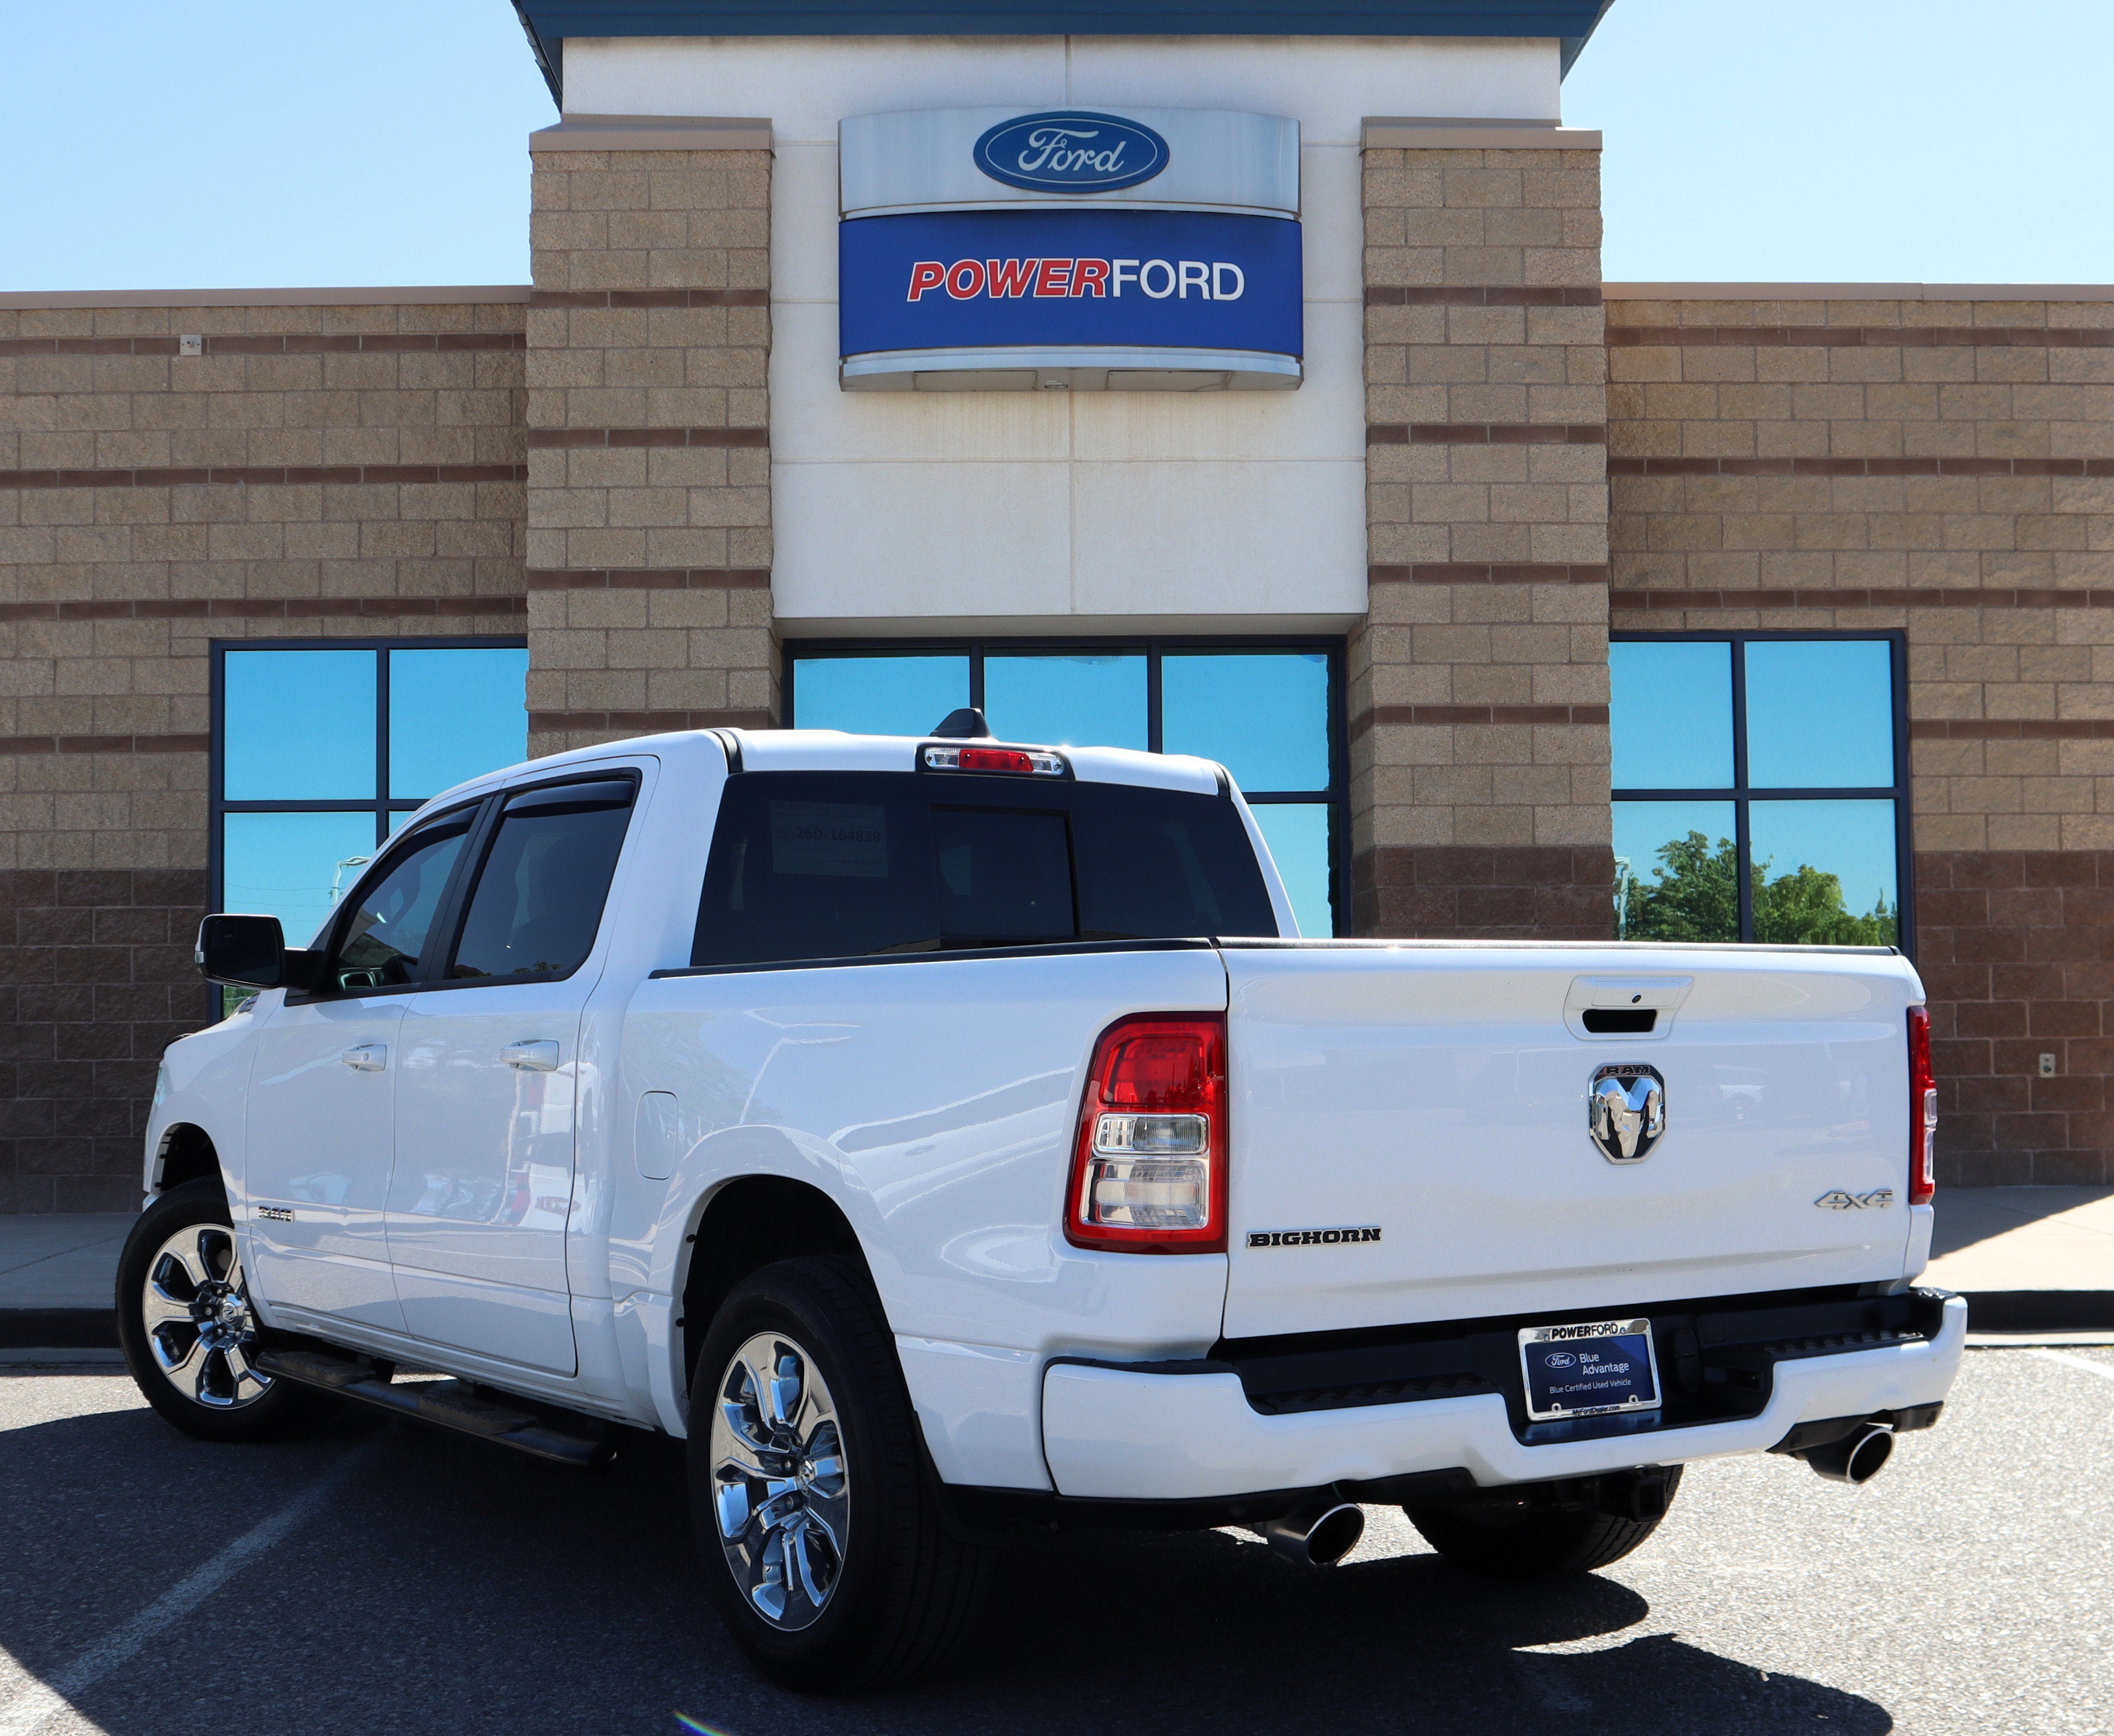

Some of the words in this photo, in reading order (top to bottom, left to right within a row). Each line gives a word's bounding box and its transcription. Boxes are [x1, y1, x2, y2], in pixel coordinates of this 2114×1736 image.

[1018, 128, 1127, 172] Ford
[907, 258, 1246, 302] POWERFORD
[1605, 1065, 1651, 1075] RAM
[258, 1205, 293, 1222] RAM
[1247, 1226, 1382, 1248] BIGHORN
[1551, 1324, 1619, 1340] POWERFORD
[1551, 1355, 1571, 1366] Ford
[1579, 1352, 1600, 1363] Blue
[1583, 1362, 1630, 1376] Advantage
[1565, 1382, 1591, 1392] Certified
[1592, 1380, 1609, 1389] Used
[1609, 1378, 1631, 1387] Vehicle
